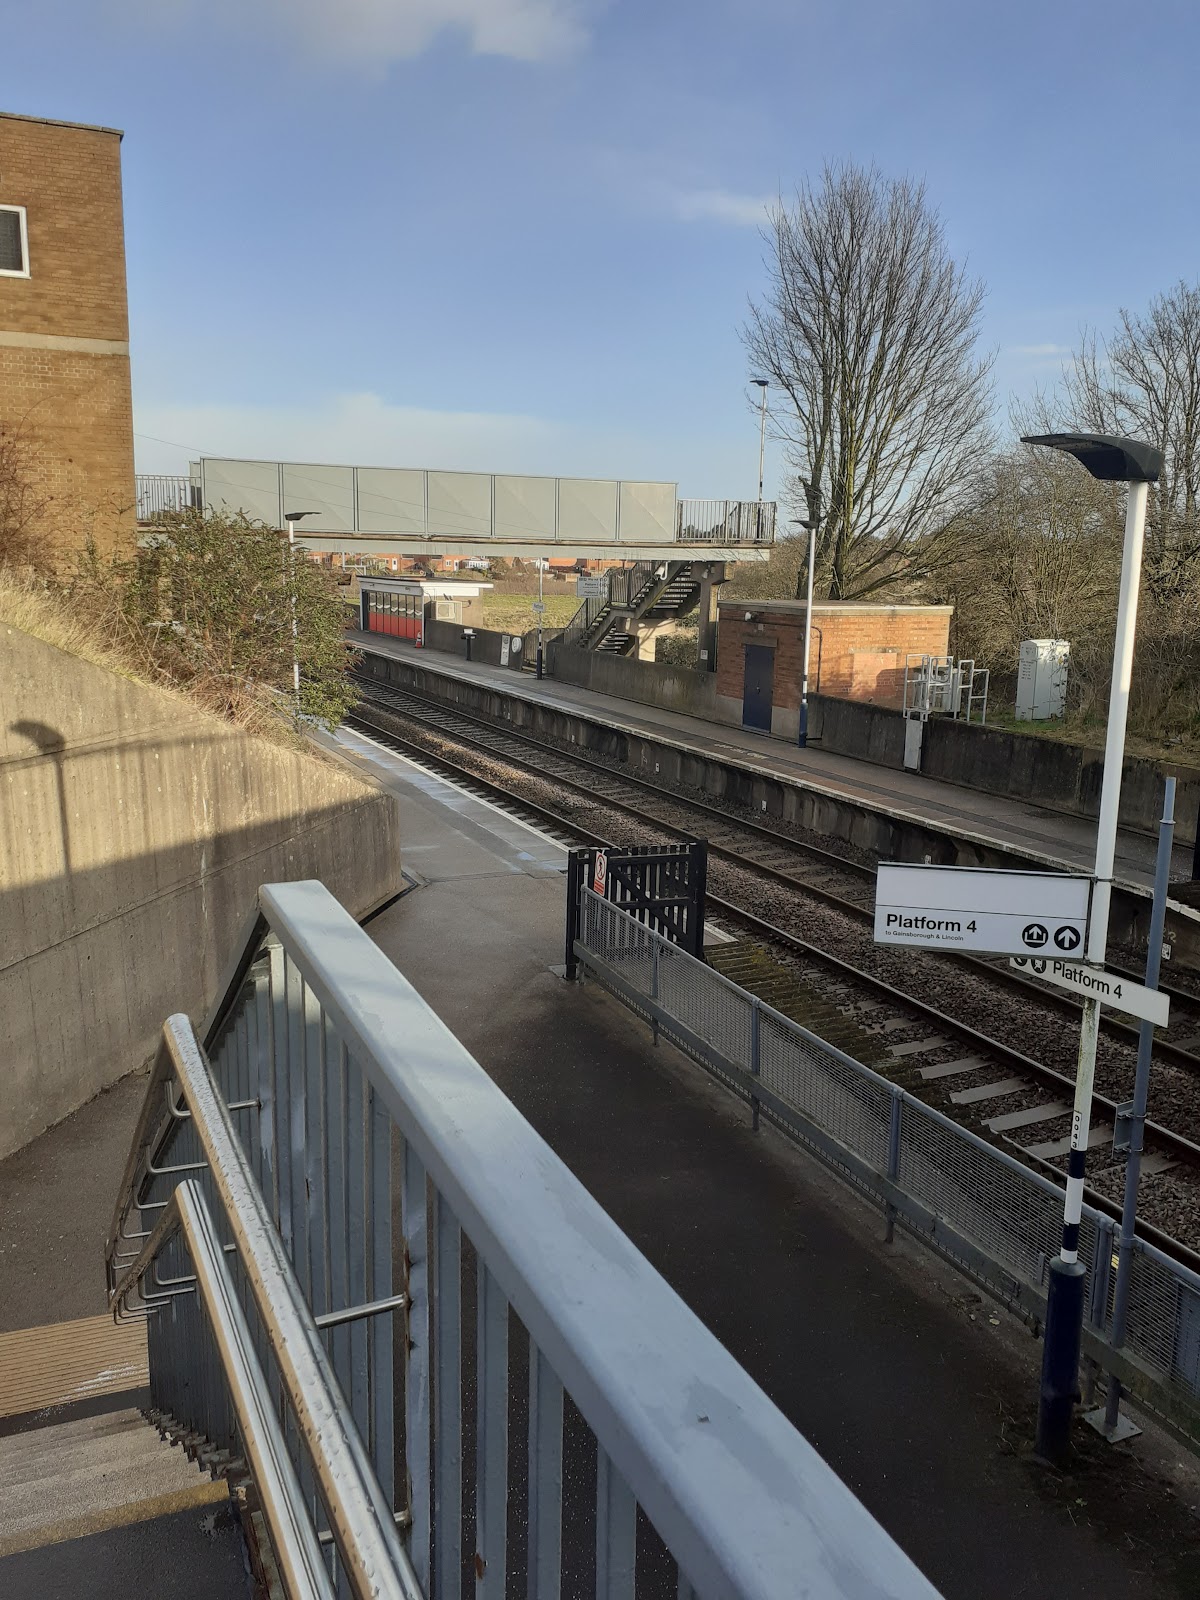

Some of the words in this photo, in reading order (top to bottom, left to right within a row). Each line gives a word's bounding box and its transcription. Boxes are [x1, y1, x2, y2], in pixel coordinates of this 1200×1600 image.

[886, 913, 961, 932] Platform
[966, 920, 977, 933] 4
[892, 930, 935, 939] Gainsborough
[1053, 960, 1110, 995] Platform
[1113, 984, 1122, 999] 4
[1072, 1115, 1080, 1148] 0043
